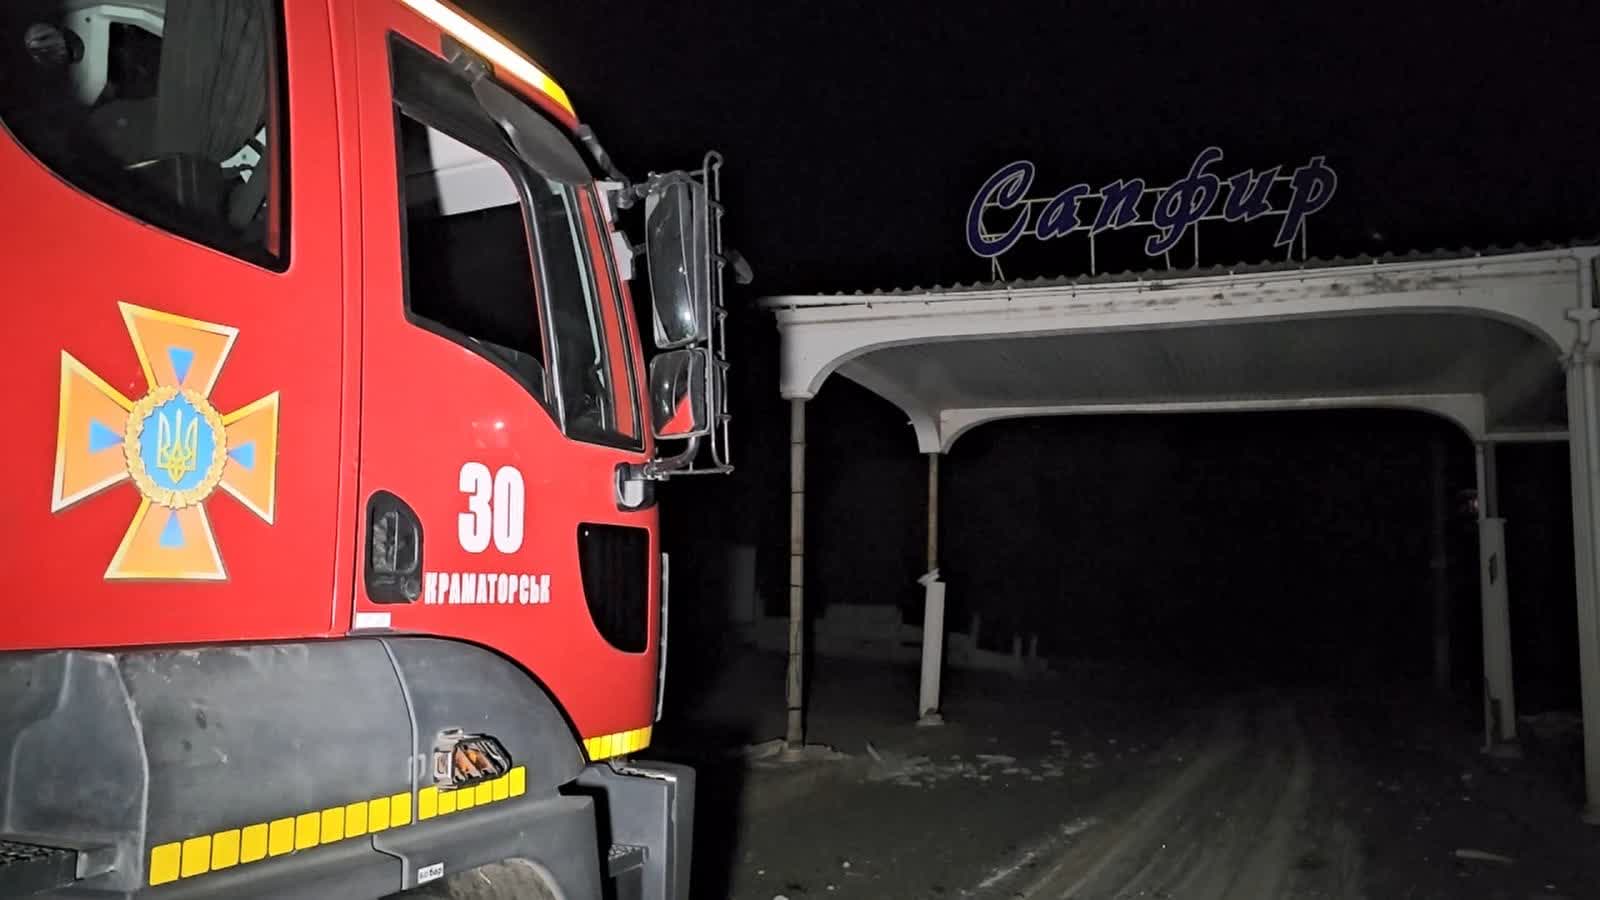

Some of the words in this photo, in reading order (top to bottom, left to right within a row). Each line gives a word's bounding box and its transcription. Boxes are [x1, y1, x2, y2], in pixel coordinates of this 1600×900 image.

[967, 147, 1337, 257] Сапфир
[459, 462, 525, 553] 30
[424, 572, 551, 605] КРАМАТОРСЬК
